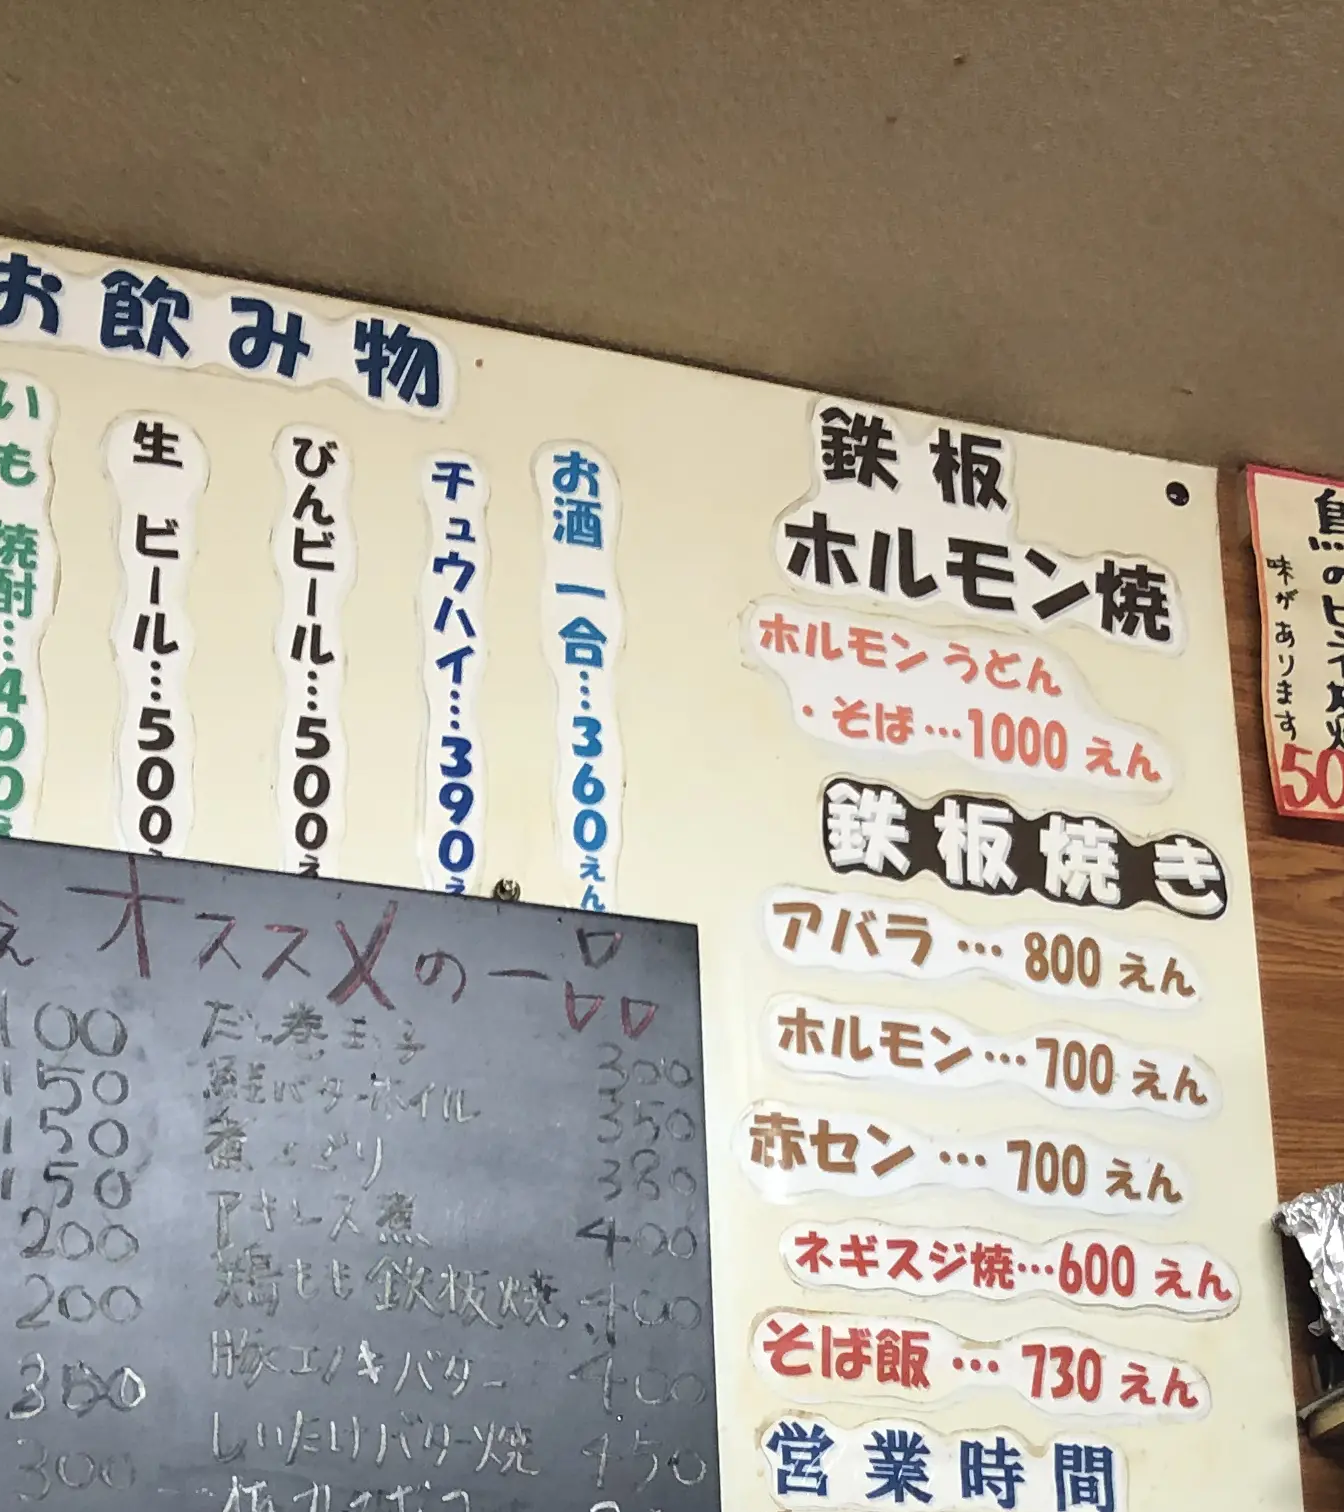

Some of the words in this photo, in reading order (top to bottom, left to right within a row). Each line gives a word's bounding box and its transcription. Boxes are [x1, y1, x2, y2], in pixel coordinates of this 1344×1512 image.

[820, 406, 1009, 512] 鉄板
[784, 511, 1171, 643] ホルモン焼
[1266, 554, 1298, 741] 味があります
[823, 780, 1225, 915] 鉄板焼き
[1, 1058, 131, 1118] 150
[2, 1108, 130, 1156] 150
[21, 1205, 142, 1263] 200
[575, 1216, 697, 1270] 400
[16, 1273, 145, 1331] 200
